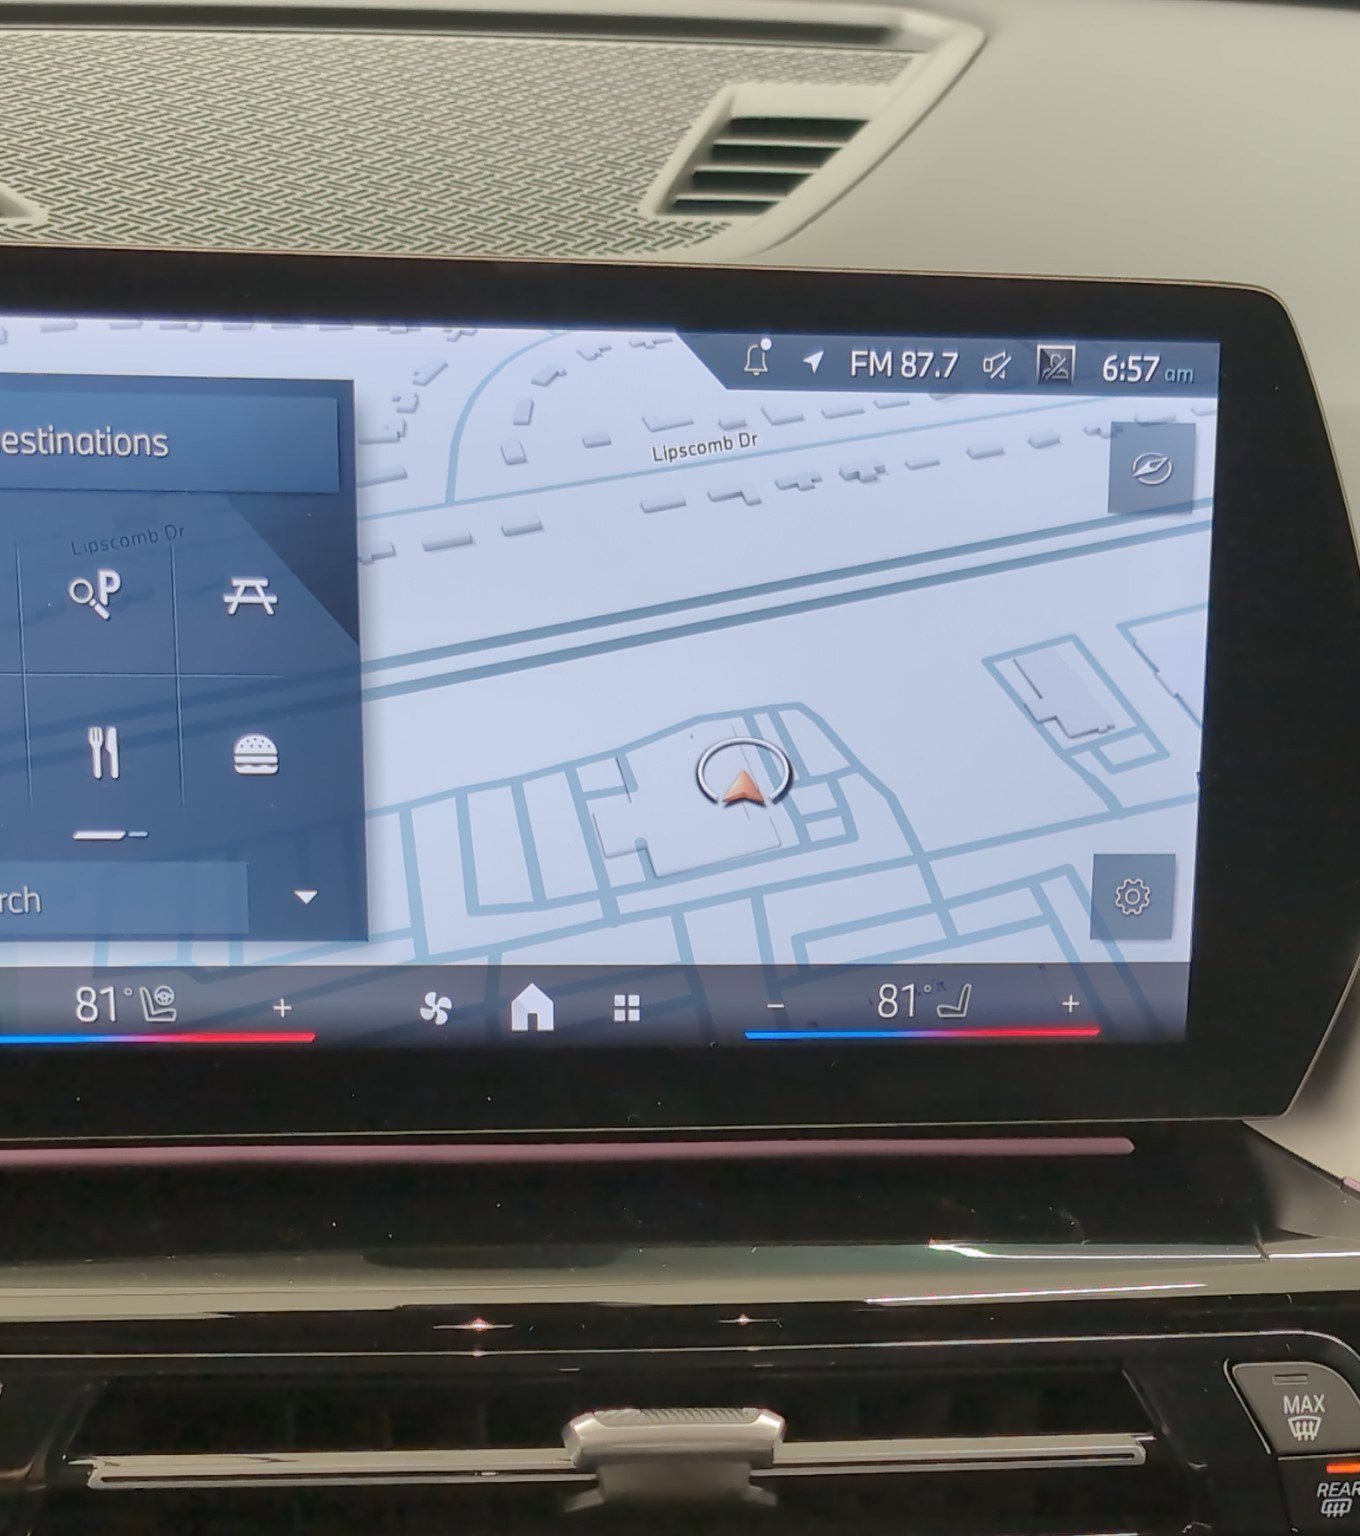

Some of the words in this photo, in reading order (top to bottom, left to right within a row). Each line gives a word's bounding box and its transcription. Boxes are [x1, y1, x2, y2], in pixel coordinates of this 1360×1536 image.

[850, 350, 892, 377] FM
[900, 351, 959, 379] 87.7
[1103, 354, 1160, 382] 6:57
[1164, 368, 1195, 383] am
[652, 435, 733, 462] Lipscomb
[739, 431, 758, 448] Dr
[70, 529, 158, 556] Lipscomb
[165, 524, 185, 541] Dr
[1283, 1394, 1325, 1414] MAX
